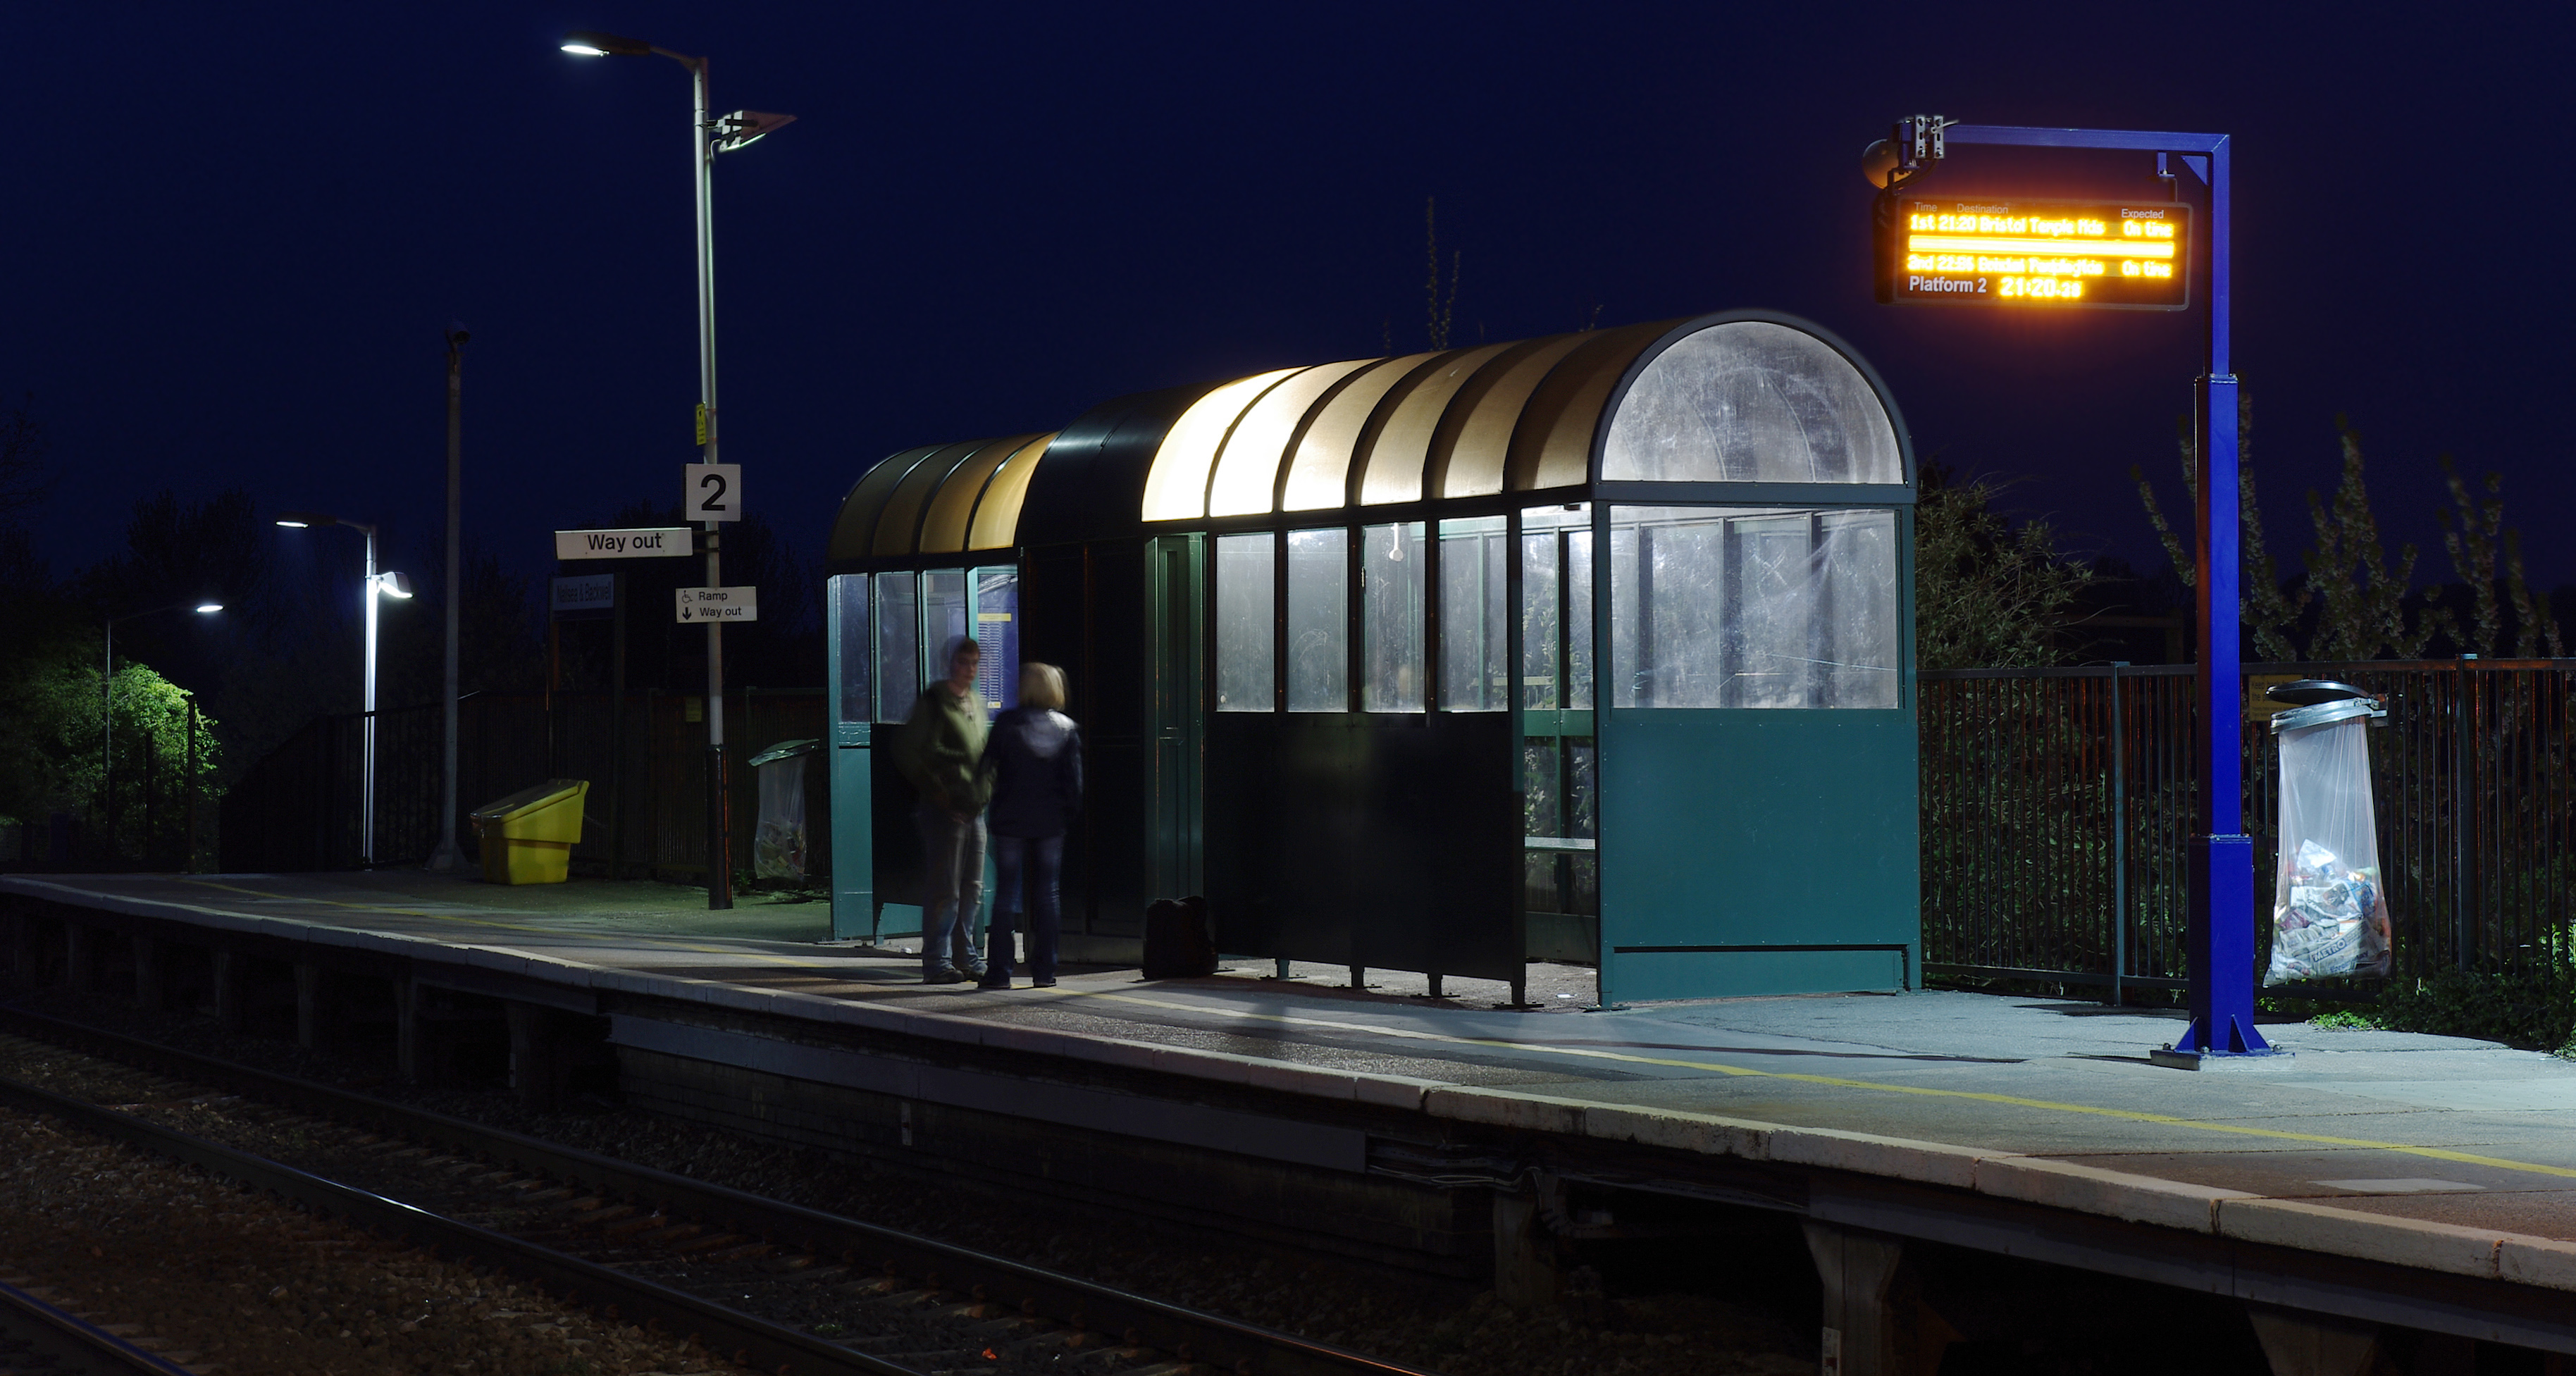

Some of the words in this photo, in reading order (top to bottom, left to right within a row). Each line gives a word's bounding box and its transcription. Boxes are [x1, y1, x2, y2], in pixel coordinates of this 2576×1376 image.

[1914, 202, 1937, 211] Time
[1957, 203, 2008, 214] Destination
[2121, 209, 2164, 220] Expected
[1911, 215, 1935, 230] 1st
[1980, 217, 2026, 233] Bristol
[2030, 218, 2074, 236] Temple
[2124, 221, 2142, 236] On
[2145, 222, 2172, 237] time
[2122, 261, 2140, 275] On
[2143, 261, 2171, 277] time
[1909, 275, 1974, 293] Platform
[1977, 278, 1988, 293] 2
[700, 473, 726, 511] 2
[587, 534, 626, 552] Way
[633, 533, 662, 549] out
[699, 591, 729, 602] Ramp
[700, 607, 722, 618] Way
[725, 606, 742, 616] out
[2312, 938, 2346, 962] METRO
